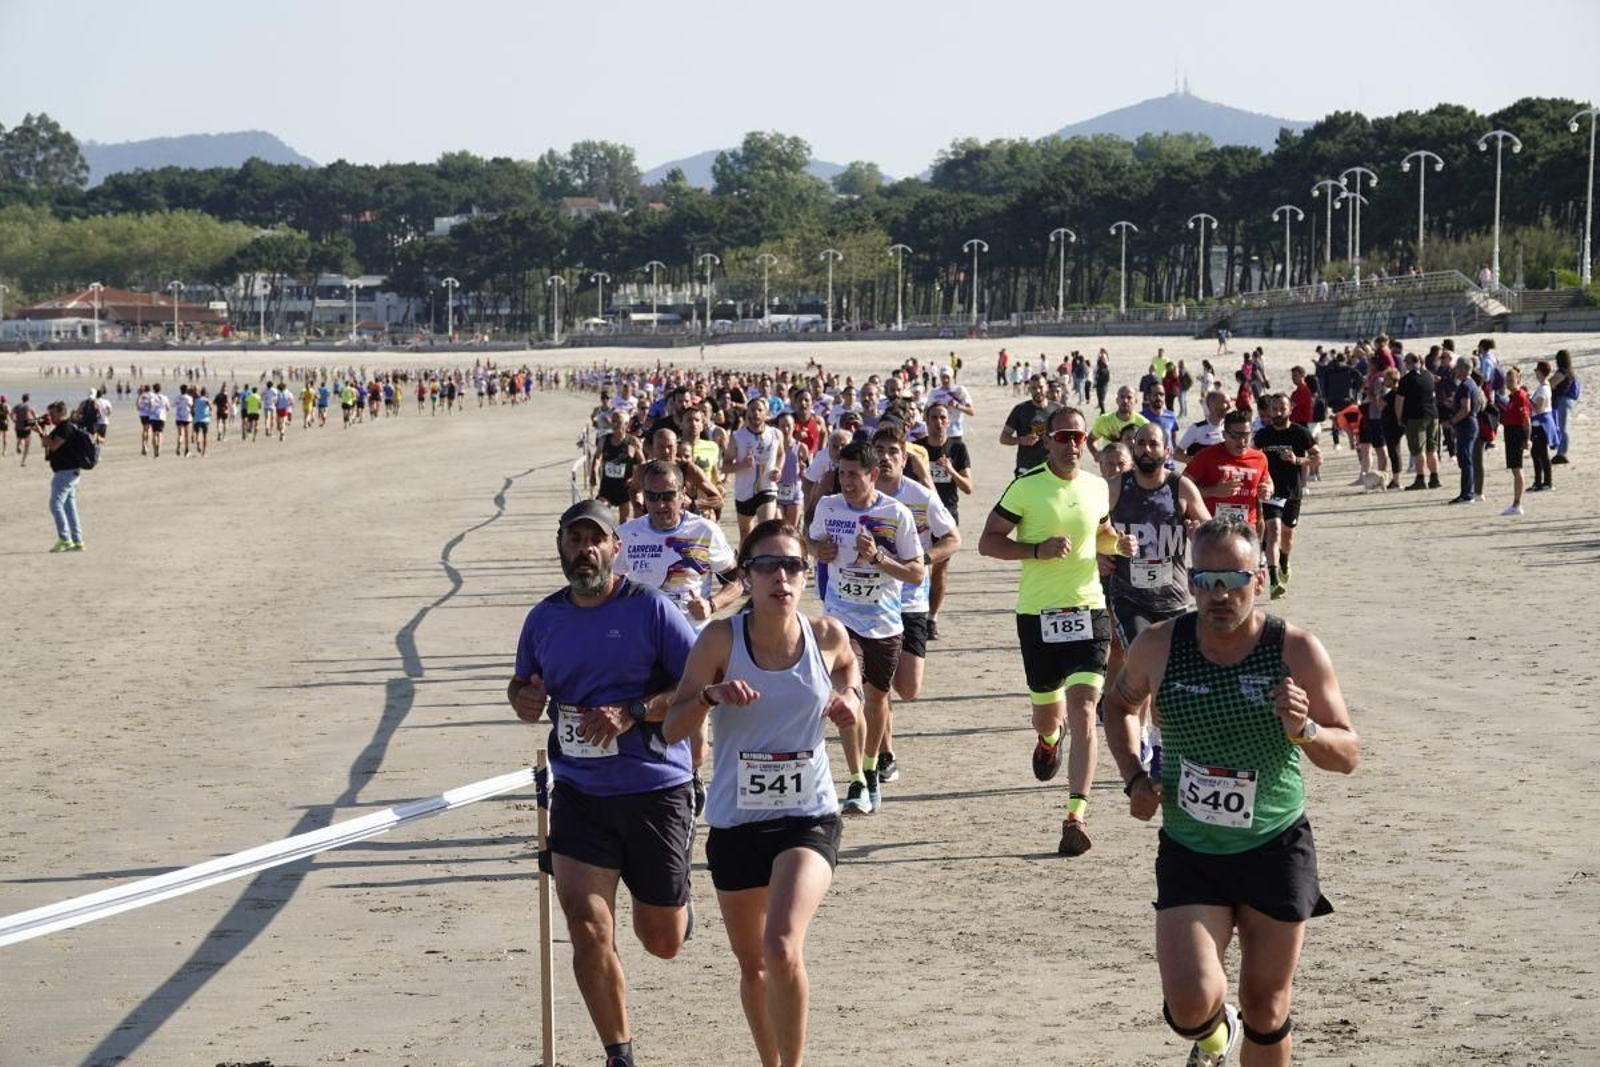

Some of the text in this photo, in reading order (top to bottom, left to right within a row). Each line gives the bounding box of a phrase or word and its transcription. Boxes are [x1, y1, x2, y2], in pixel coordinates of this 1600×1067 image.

[1147, 570, 1157, 581] 5
[842, 583, 875, 597] 437
[1050, 619, 1086, 634] 185
[748, 772, 802, 795] 541
[1186, 782, 1245, 813] 540
